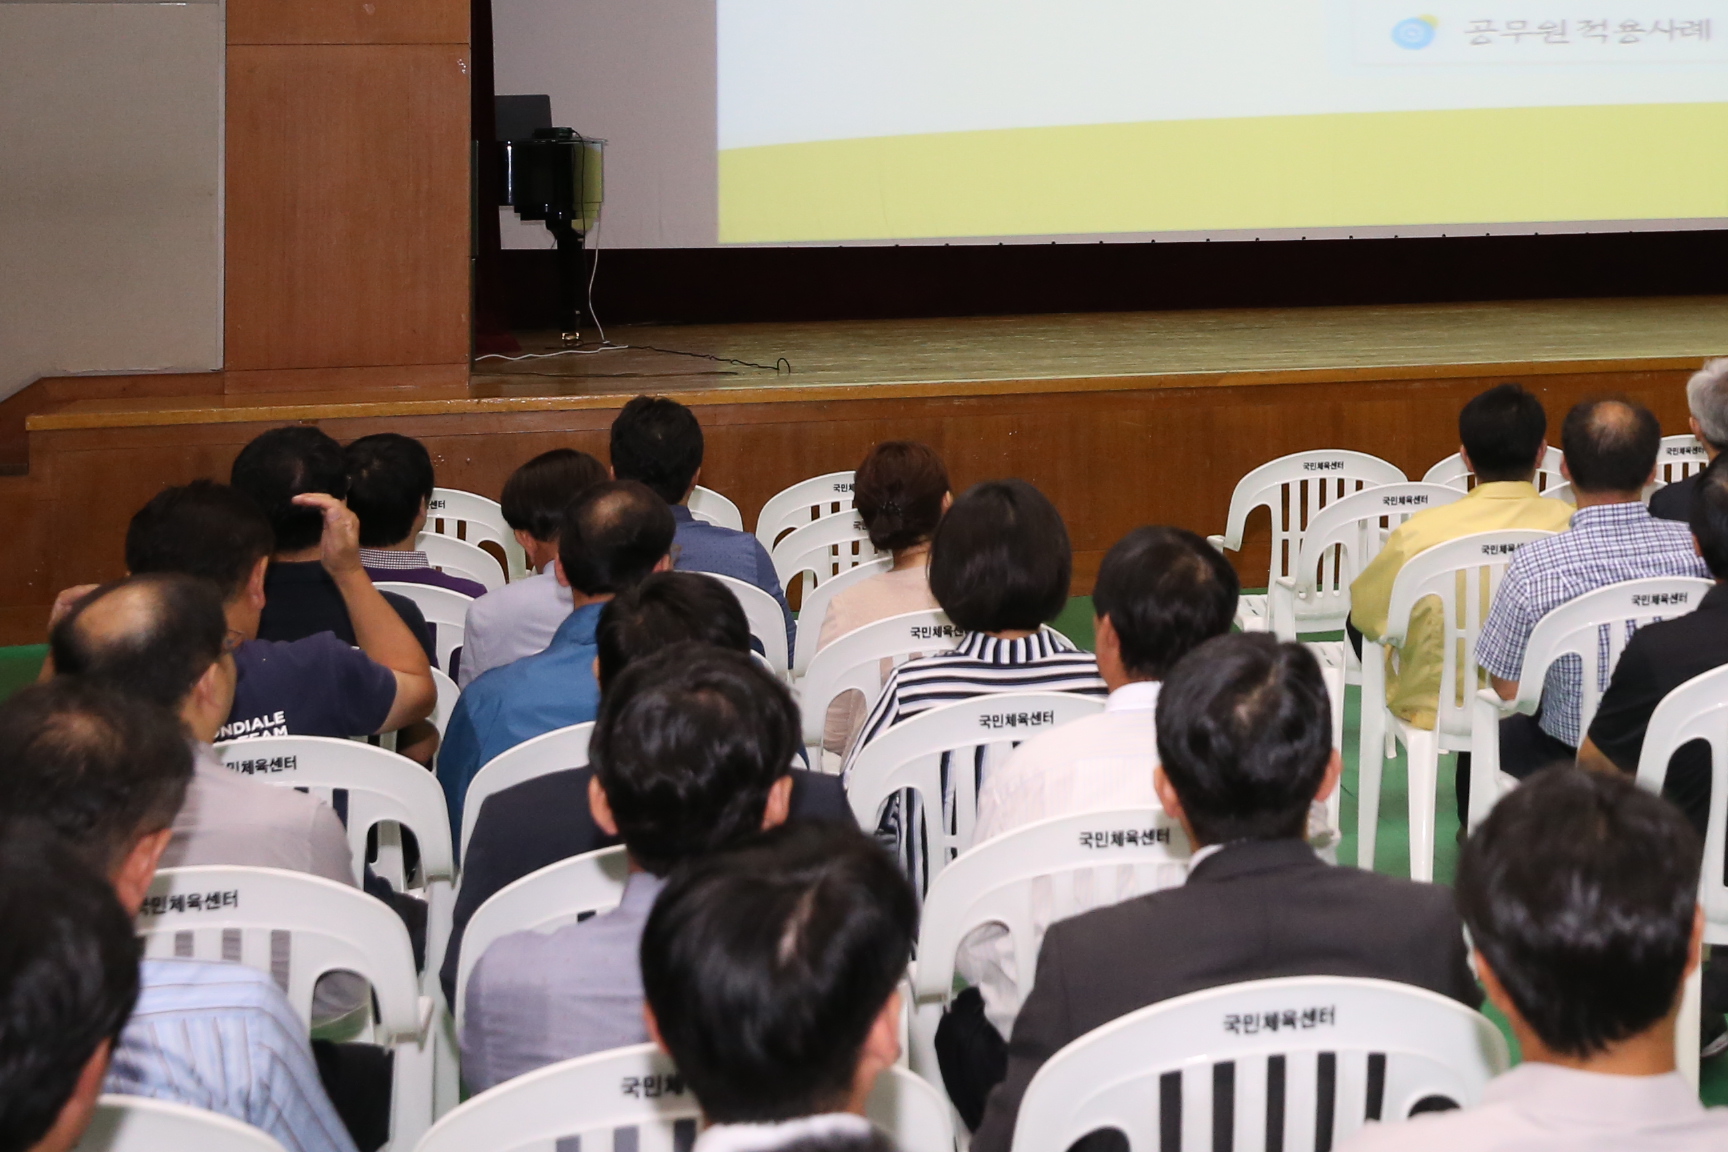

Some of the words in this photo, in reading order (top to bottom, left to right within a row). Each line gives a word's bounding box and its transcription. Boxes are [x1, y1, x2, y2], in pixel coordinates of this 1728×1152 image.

[1464, 17, 1571, 47] 공무원
[1303, 461, 1345, 471] 국민체육센터
[1382, 494, 1429, 506] 국민체육센터
[1631, 592, 1688, 607] 국민체육센터
[979, 710, 1055, 730] 국민체육센터
[1079, 828, 1170, 849] 국민체육센터
[1223, 1004, 1335, 1035] 국민체육센터
